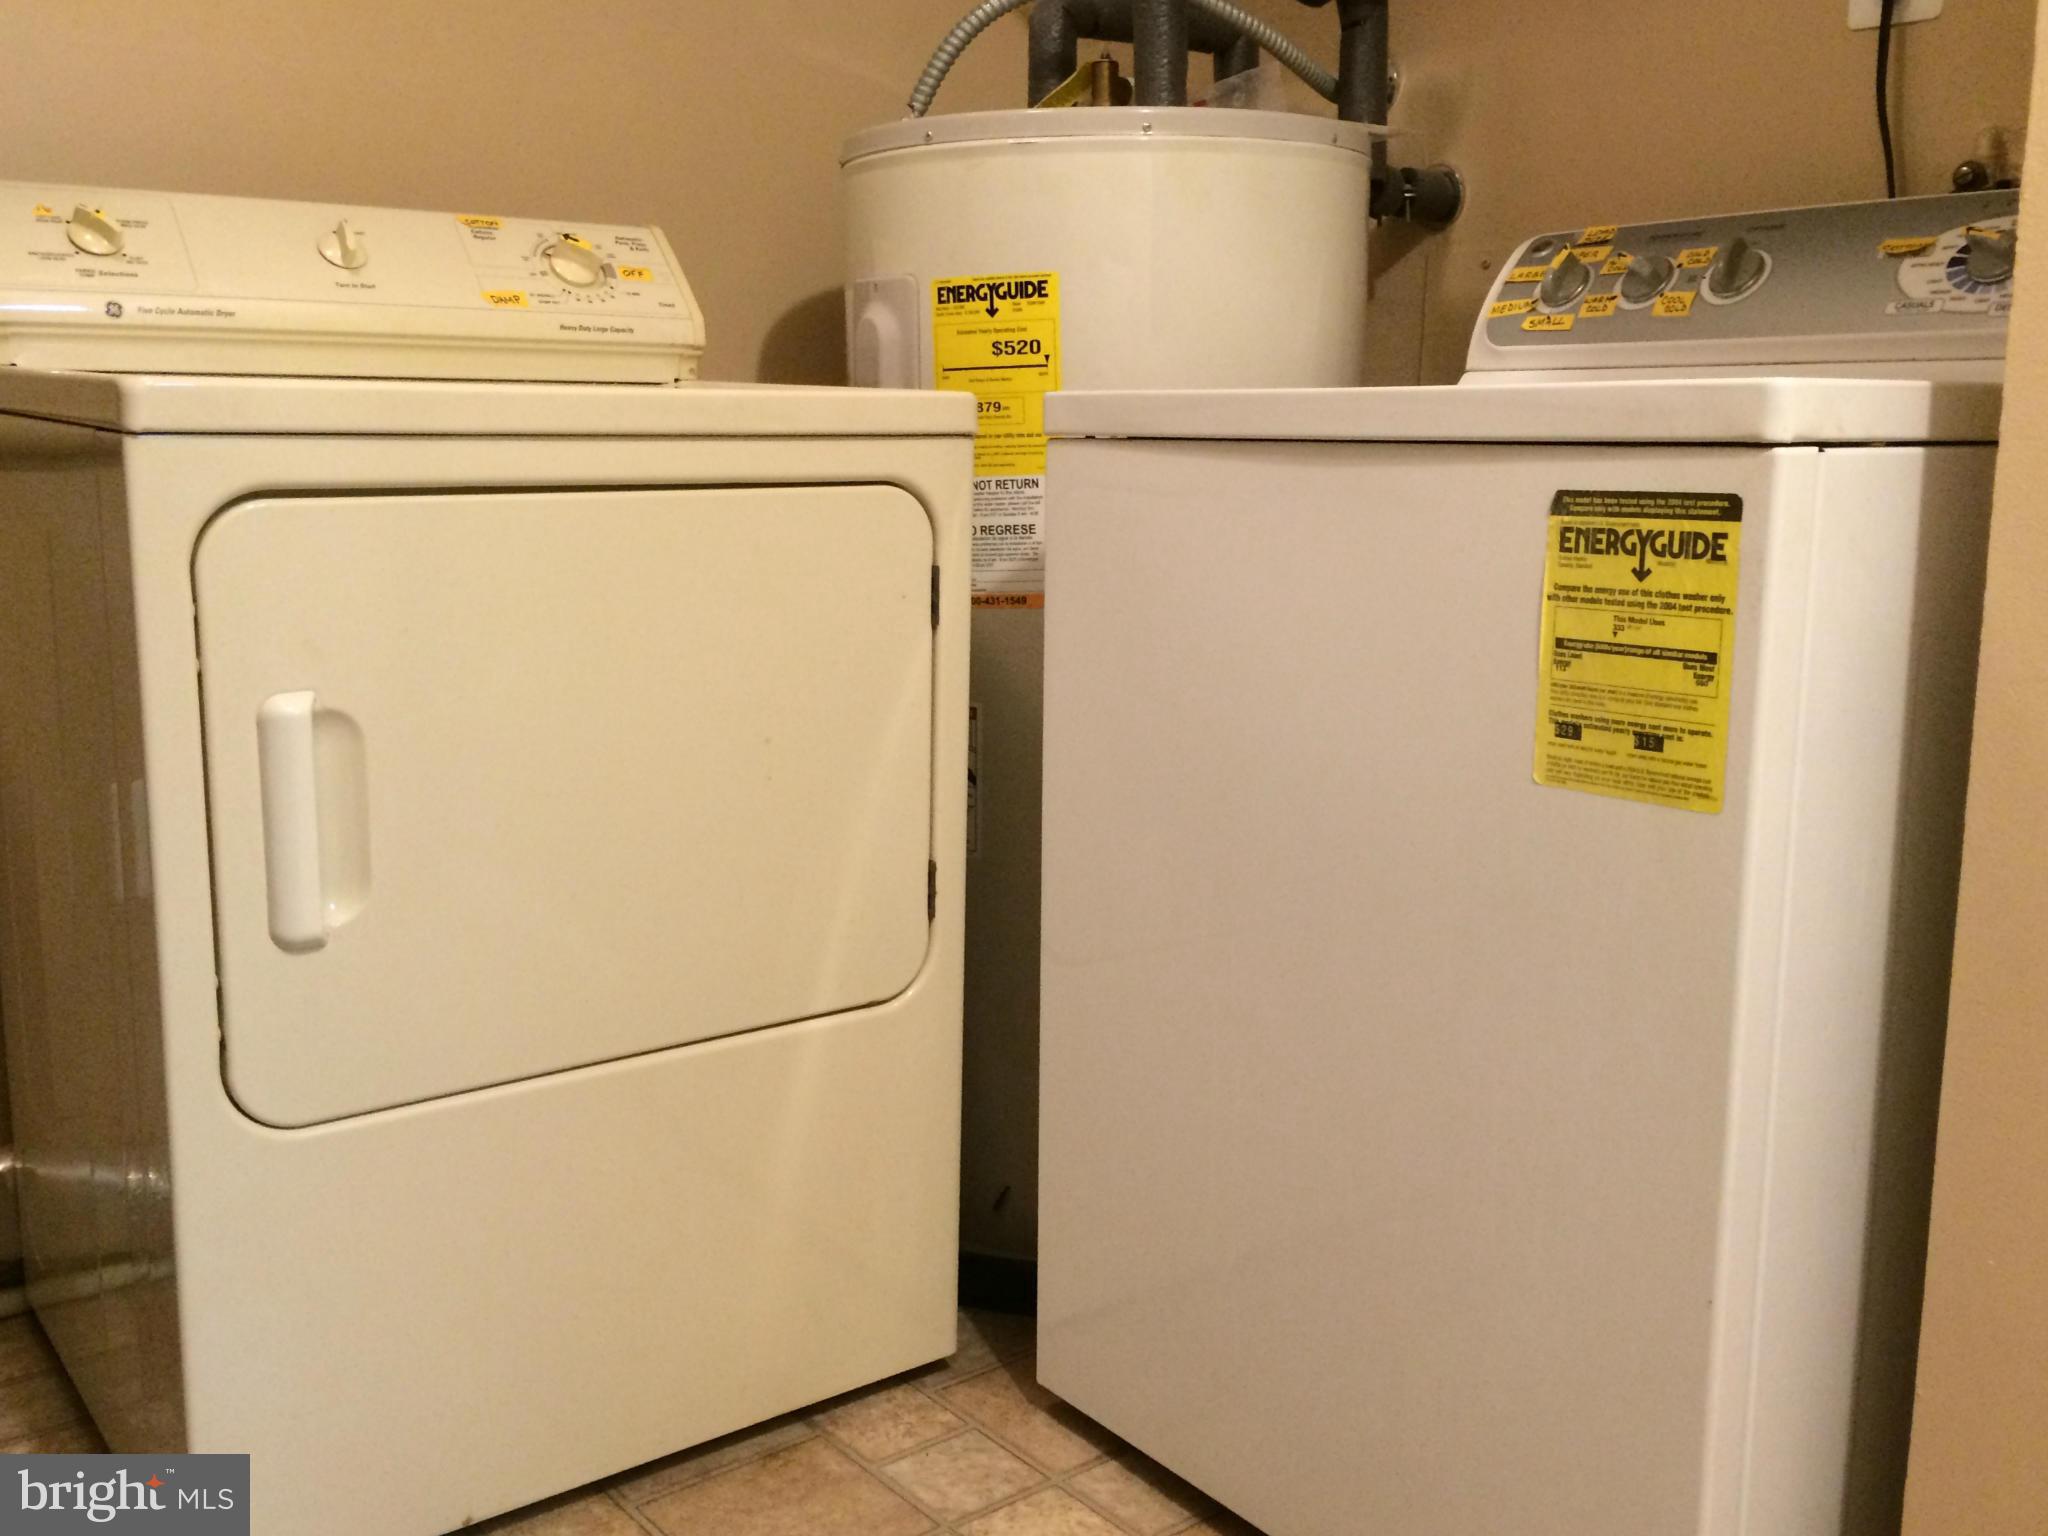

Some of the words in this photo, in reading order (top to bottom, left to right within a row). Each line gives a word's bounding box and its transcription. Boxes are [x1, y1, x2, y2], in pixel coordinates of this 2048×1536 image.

[621, 269, 644, 279] OFF
[937, 280, 1049, 305] ENERGYGUIDE
[490, 294, 521, 305] DAMP
[177, 308, 214, 317] Automatic
[216, 309, 236, 317] Dryer
[1529, 317, 1565, 328] SMALL
[559, 324, 577, 332] Heavy
[578, 324, 591, 332] Duty
[593, 326, 608, 334] Large
[610, 326, 634, 334] Capacity
[991, 339, 1041, 358] $520
[995, 478, 1039, 490] RETURN
[980, 524, 1036, 535] REGRESE
[1559, 526, 1728, 562] ENERGYGUIDE
[1553, 583, 1581, 592] Compare
[1582, 585, 1593, 593] the
[1594, 587, 1616, 596] energy
[1640, 589, 1653, 597] this
[1654, 591, 1680, 599] clothes
[1682, 593, 1708, 601] washer
[1710, 594, 1726, 604] only
[1579, 596, 1602, 605] models
[1604, 598, 1624, 607] tested
[1626, 601, 1645, 610] using
[1646, 601, 1658, 609] the
[1678, 604, 1693, 612] test
[1694, 606, 1733, 615] procedure.
[1613, 615, 1626, 623] This
[1627, 616, 1648, 625] Model
[1649, 618, 1665, 626] Uses
[1627, 721, 1647, 730] energy
